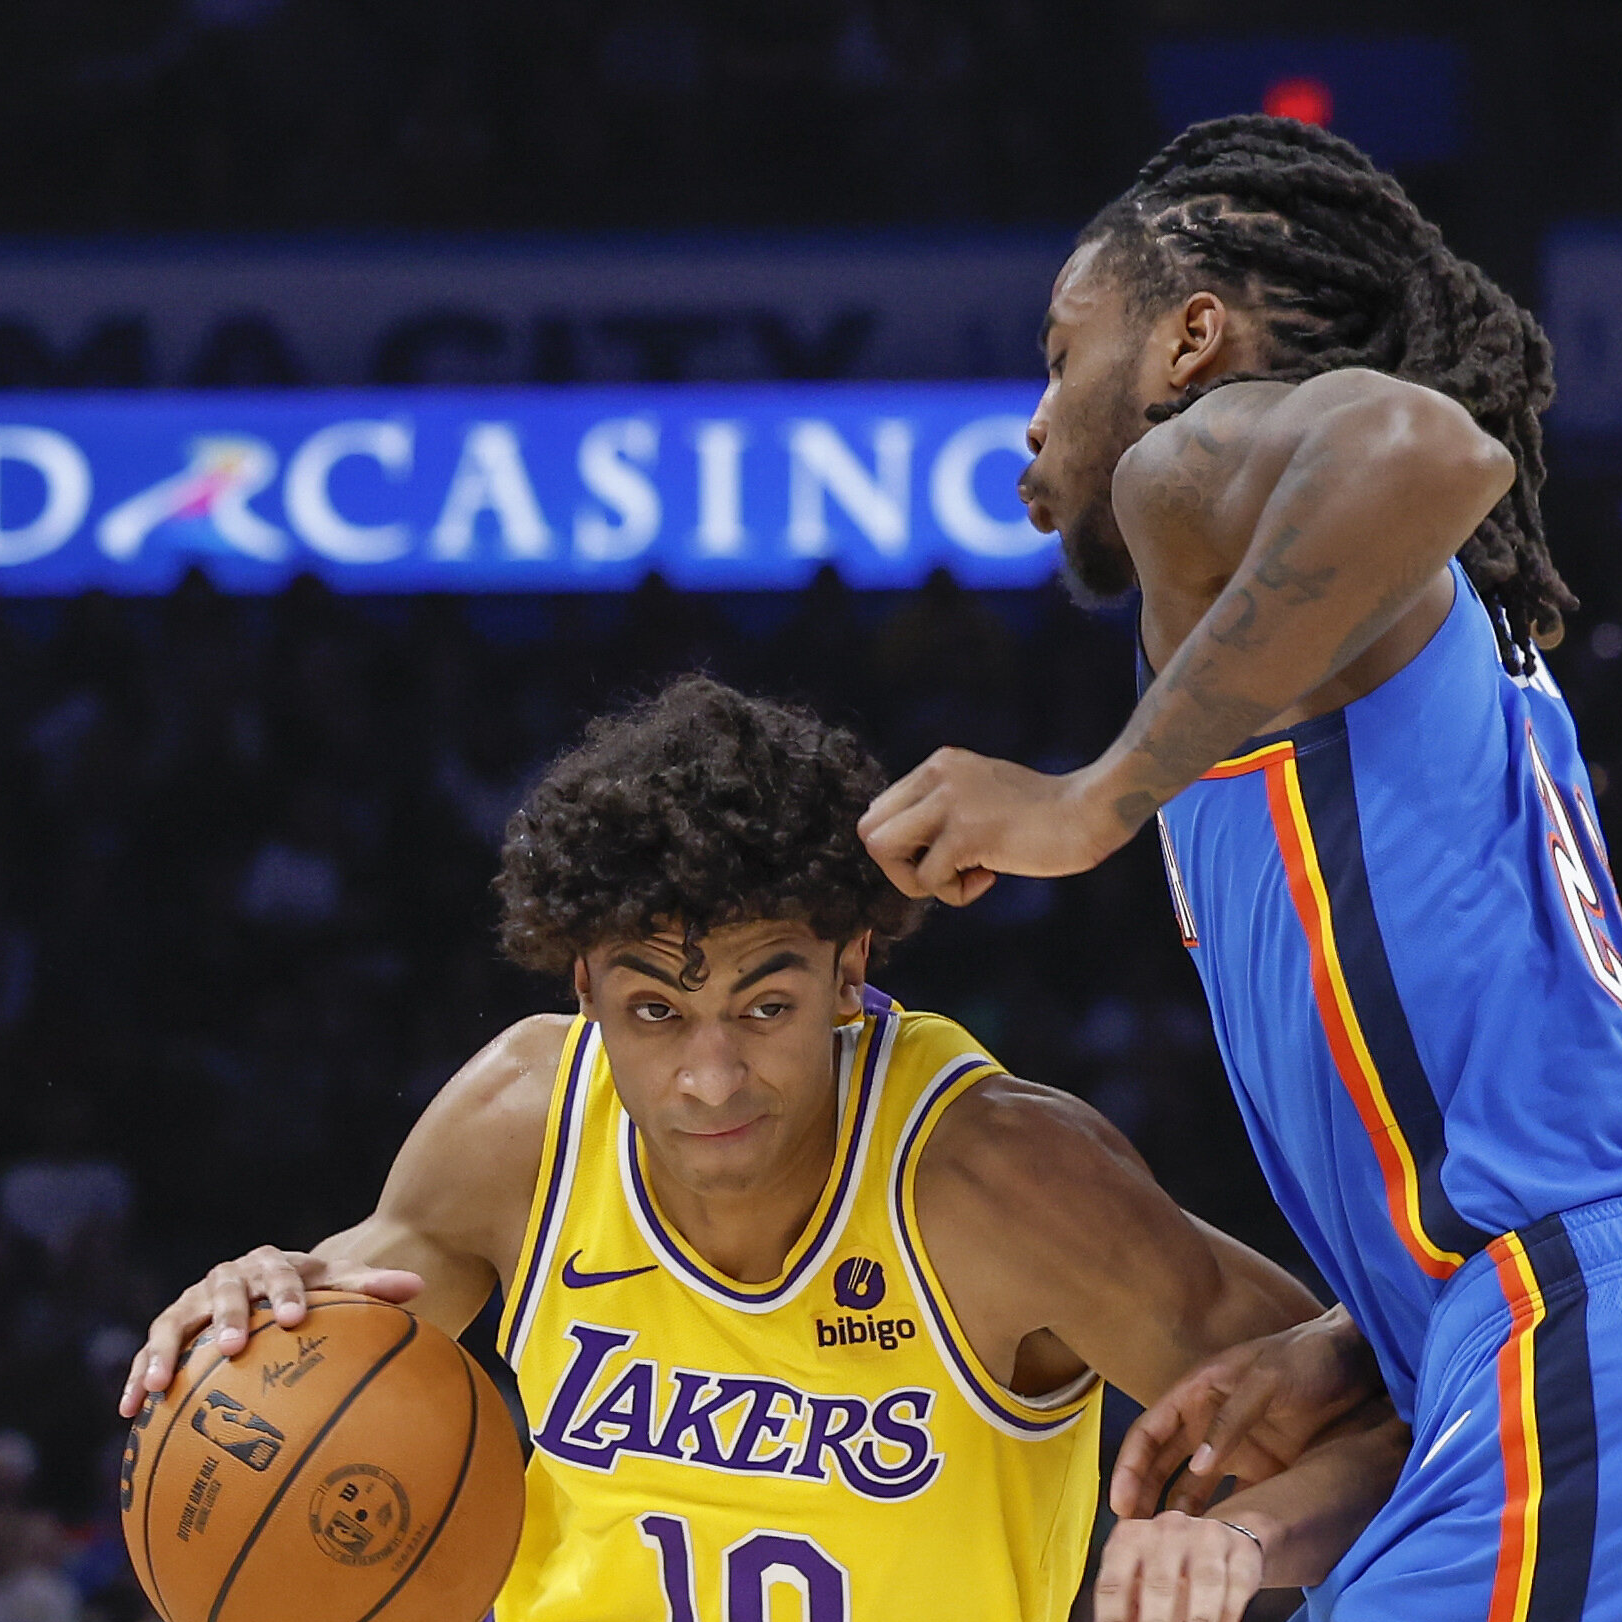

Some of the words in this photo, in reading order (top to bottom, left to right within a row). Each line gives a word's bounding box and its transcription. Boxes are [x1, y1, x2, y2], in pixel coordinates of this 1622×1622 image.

[281, 412, 1060, 566] CASINO
[816, 1315, 916, 1351] bibigo
[530, 1318, 946, 1504] LAKERS
[201, 1455, 220, 1481] BALL
